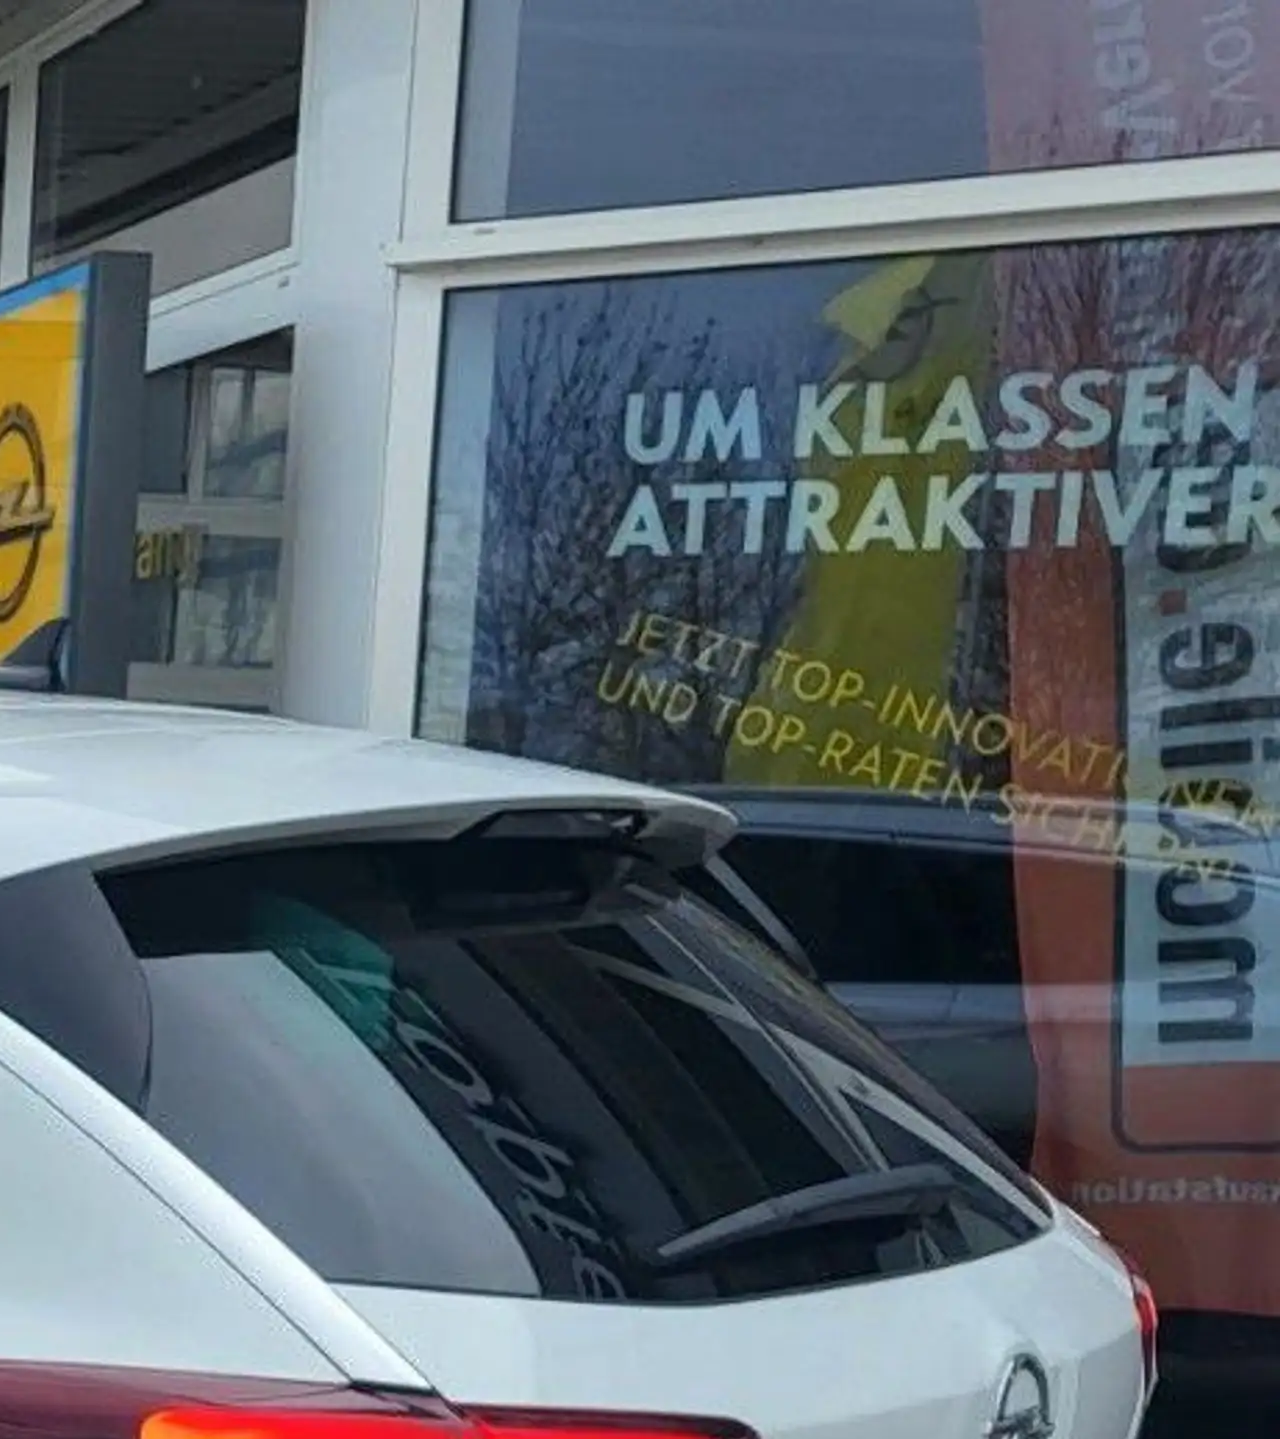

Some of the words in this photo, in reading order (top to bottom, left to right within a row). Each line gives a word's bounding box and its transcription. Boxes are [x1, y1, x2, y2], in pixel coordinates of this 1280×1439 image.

[623, 386, 763, 465] UM
[793, 359, 1259, 459] KLASSEN
[605, 463, 1280, 559] ATTRAKTIVER
[615, 609, 761, 679] JETZT
[596, 659, 699, 724] UND
[712, 692, 984, 816] TOP-RATEN
